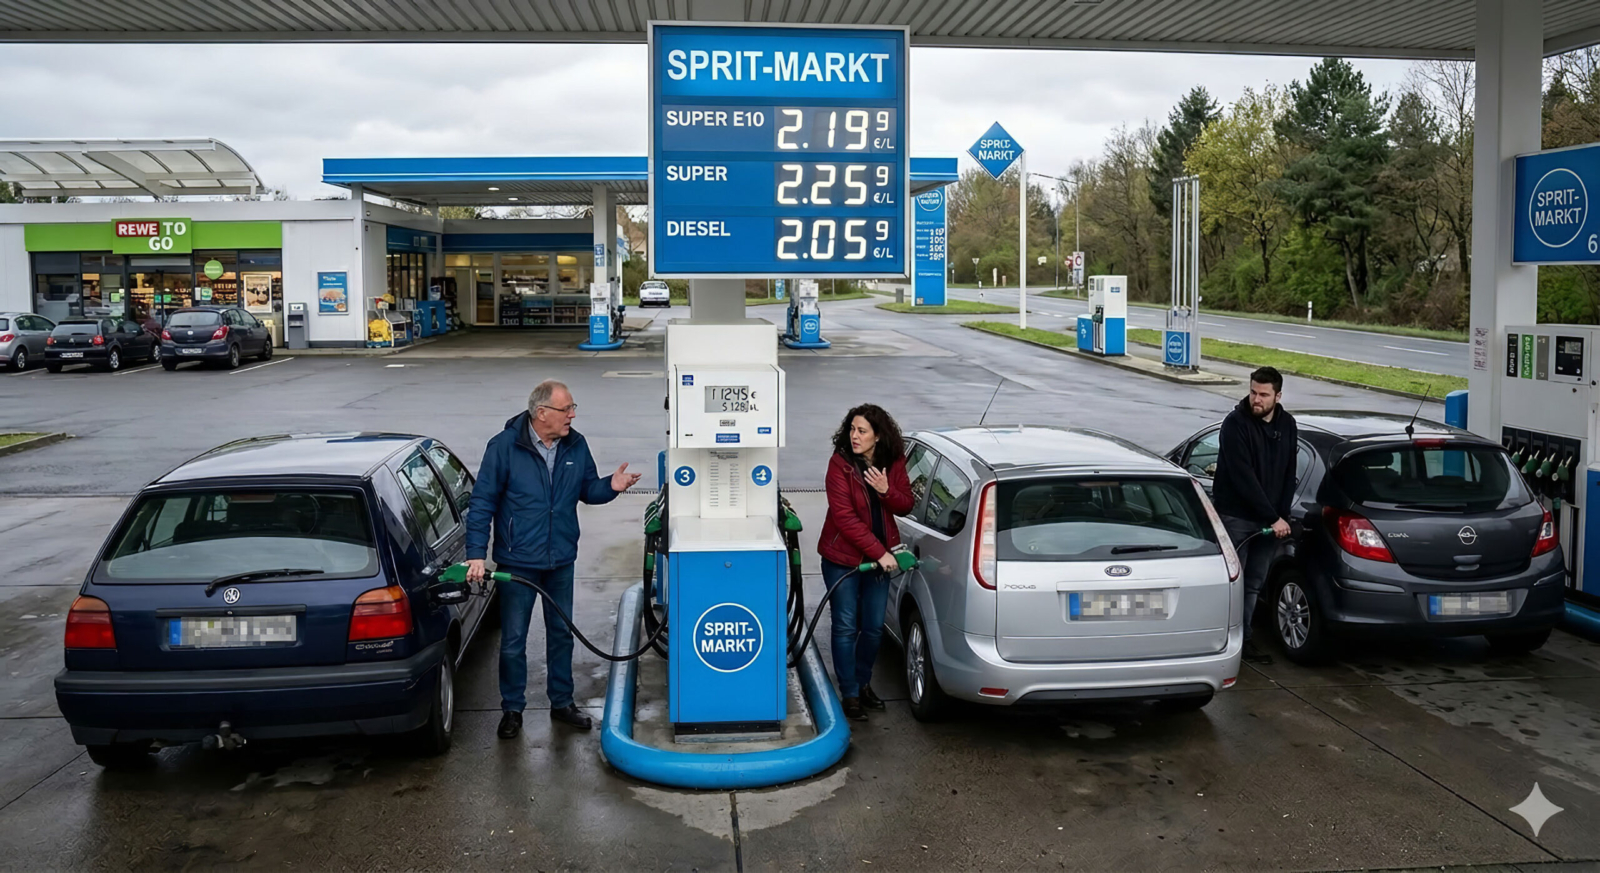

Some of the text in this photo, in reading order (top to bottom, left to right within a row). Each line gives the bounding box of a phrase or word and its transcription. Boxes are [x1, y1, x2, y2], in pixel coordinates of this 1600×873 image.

[667, 49, 890, 83] SPRIT-MARKT
[666, 110, 728, 127] SUPER
[733, 111, 765, 127] E10
[873, 138, 895, 149] €/L
[666, 165, 728, 181] SUPER
[776, 164, 867, 205] 2.25
[873, 193, 895, 204] €/L
[1537, 188, 1580, 207] SPRIT-
[1534, 207, 1582, 227] MARKT
[118, 221, 187, 236] REWE TO
[148, 236, 174, 251] GO
[666, 221, 731, 237] DIESEL
[776, 219, 867, 260] 2.05
[1587, 233, 1599, 254] 6
[680, 470, 690, 483] 3
[704, 621, 754, 636] SPRIT-
[701, 638, 756, 653] MARKT
